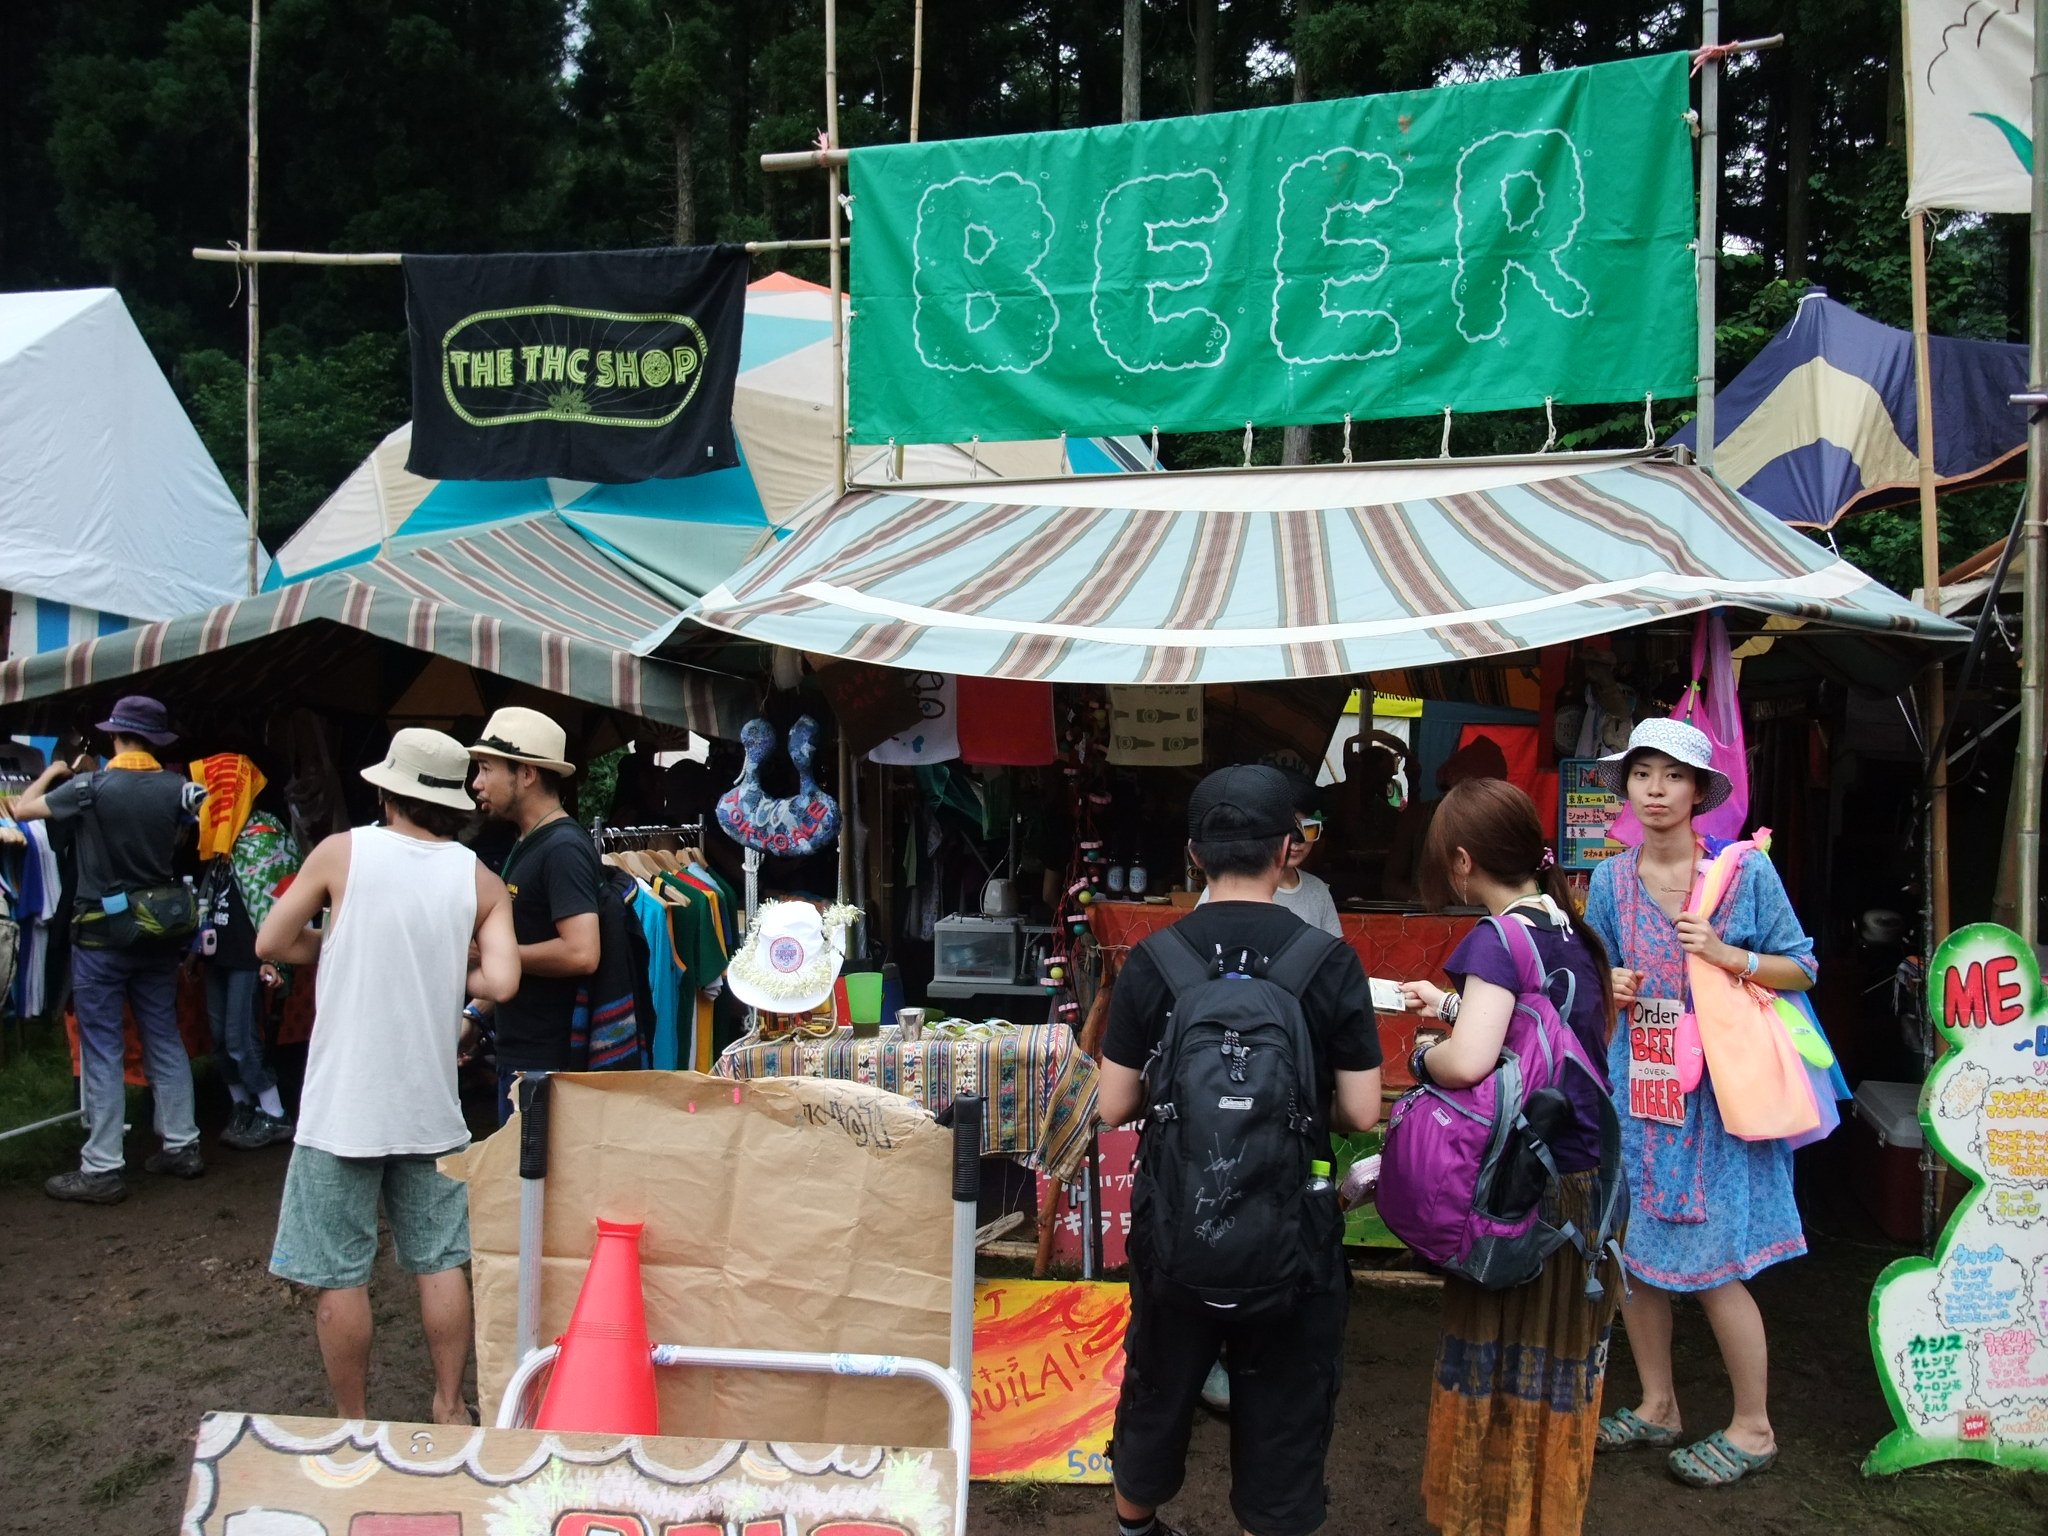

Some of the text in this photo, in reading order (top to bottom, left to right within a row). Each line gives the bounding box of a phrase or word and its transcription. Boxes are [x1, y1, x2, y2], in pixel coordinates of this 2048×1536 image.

[913, 129, 1590, 374] BEER
[449, 345, 698, 388] THE THC SHOP
[1568, 794, 1602, 804] 東京エール
[725, 789, 829, 851] TOKYO ALE
[1604, 812, 1617, 821] 500
[1633, 1002, 1679, 1024] Order
[1630, 1078, 1684, 1120] HEER
[1908, 1333, 1963, 1356] カシス
[1911, 1354, 1958, 1369] オレンジ
[1914, 1365, 1957, 1381] マンゴー
[1913, 1379, 1962, 1393] ウーロン茶
[1920, 1391, 1953, 1403] ソーダ
[1924, 1402, 1949, 1413] ミルク
[1965, 1420, 1985, 1431] new
